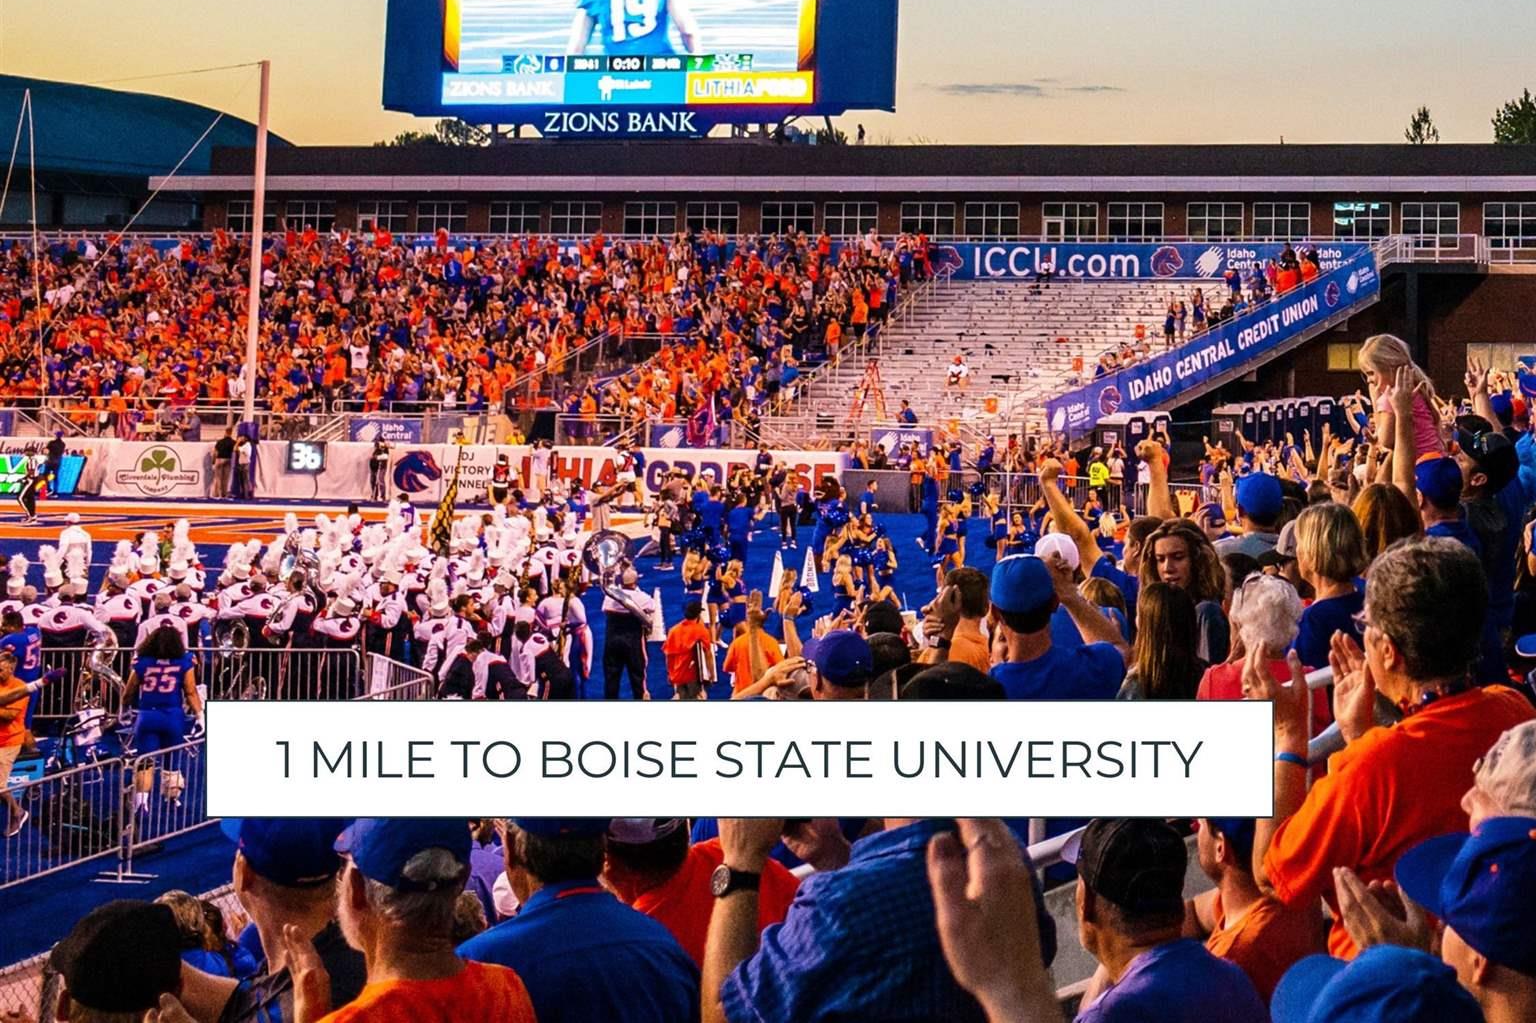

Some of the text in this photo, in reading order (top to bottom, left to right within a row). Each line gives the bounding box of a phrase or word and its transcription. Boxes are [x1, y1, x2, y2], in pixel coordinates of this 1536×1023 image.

[450, 81, 556, 96] ZIONS BANK
[695, 80, 755, 95] LITHIA
[544, 112, 697, 132] ZIONS BANK
[1227, 249, 1256, 259] Idaho
[975, 247, 1140, 277] ICCU.com
[1128, 295, 1319, 400] IDAHO CENTRAL CREDIT UNION
[382, 423, 405, 432] Idaho
[382, 431, 412, 440] Central
[444, 478, 487, 489] TNNEL
[142, 666, 181, 693] 55
